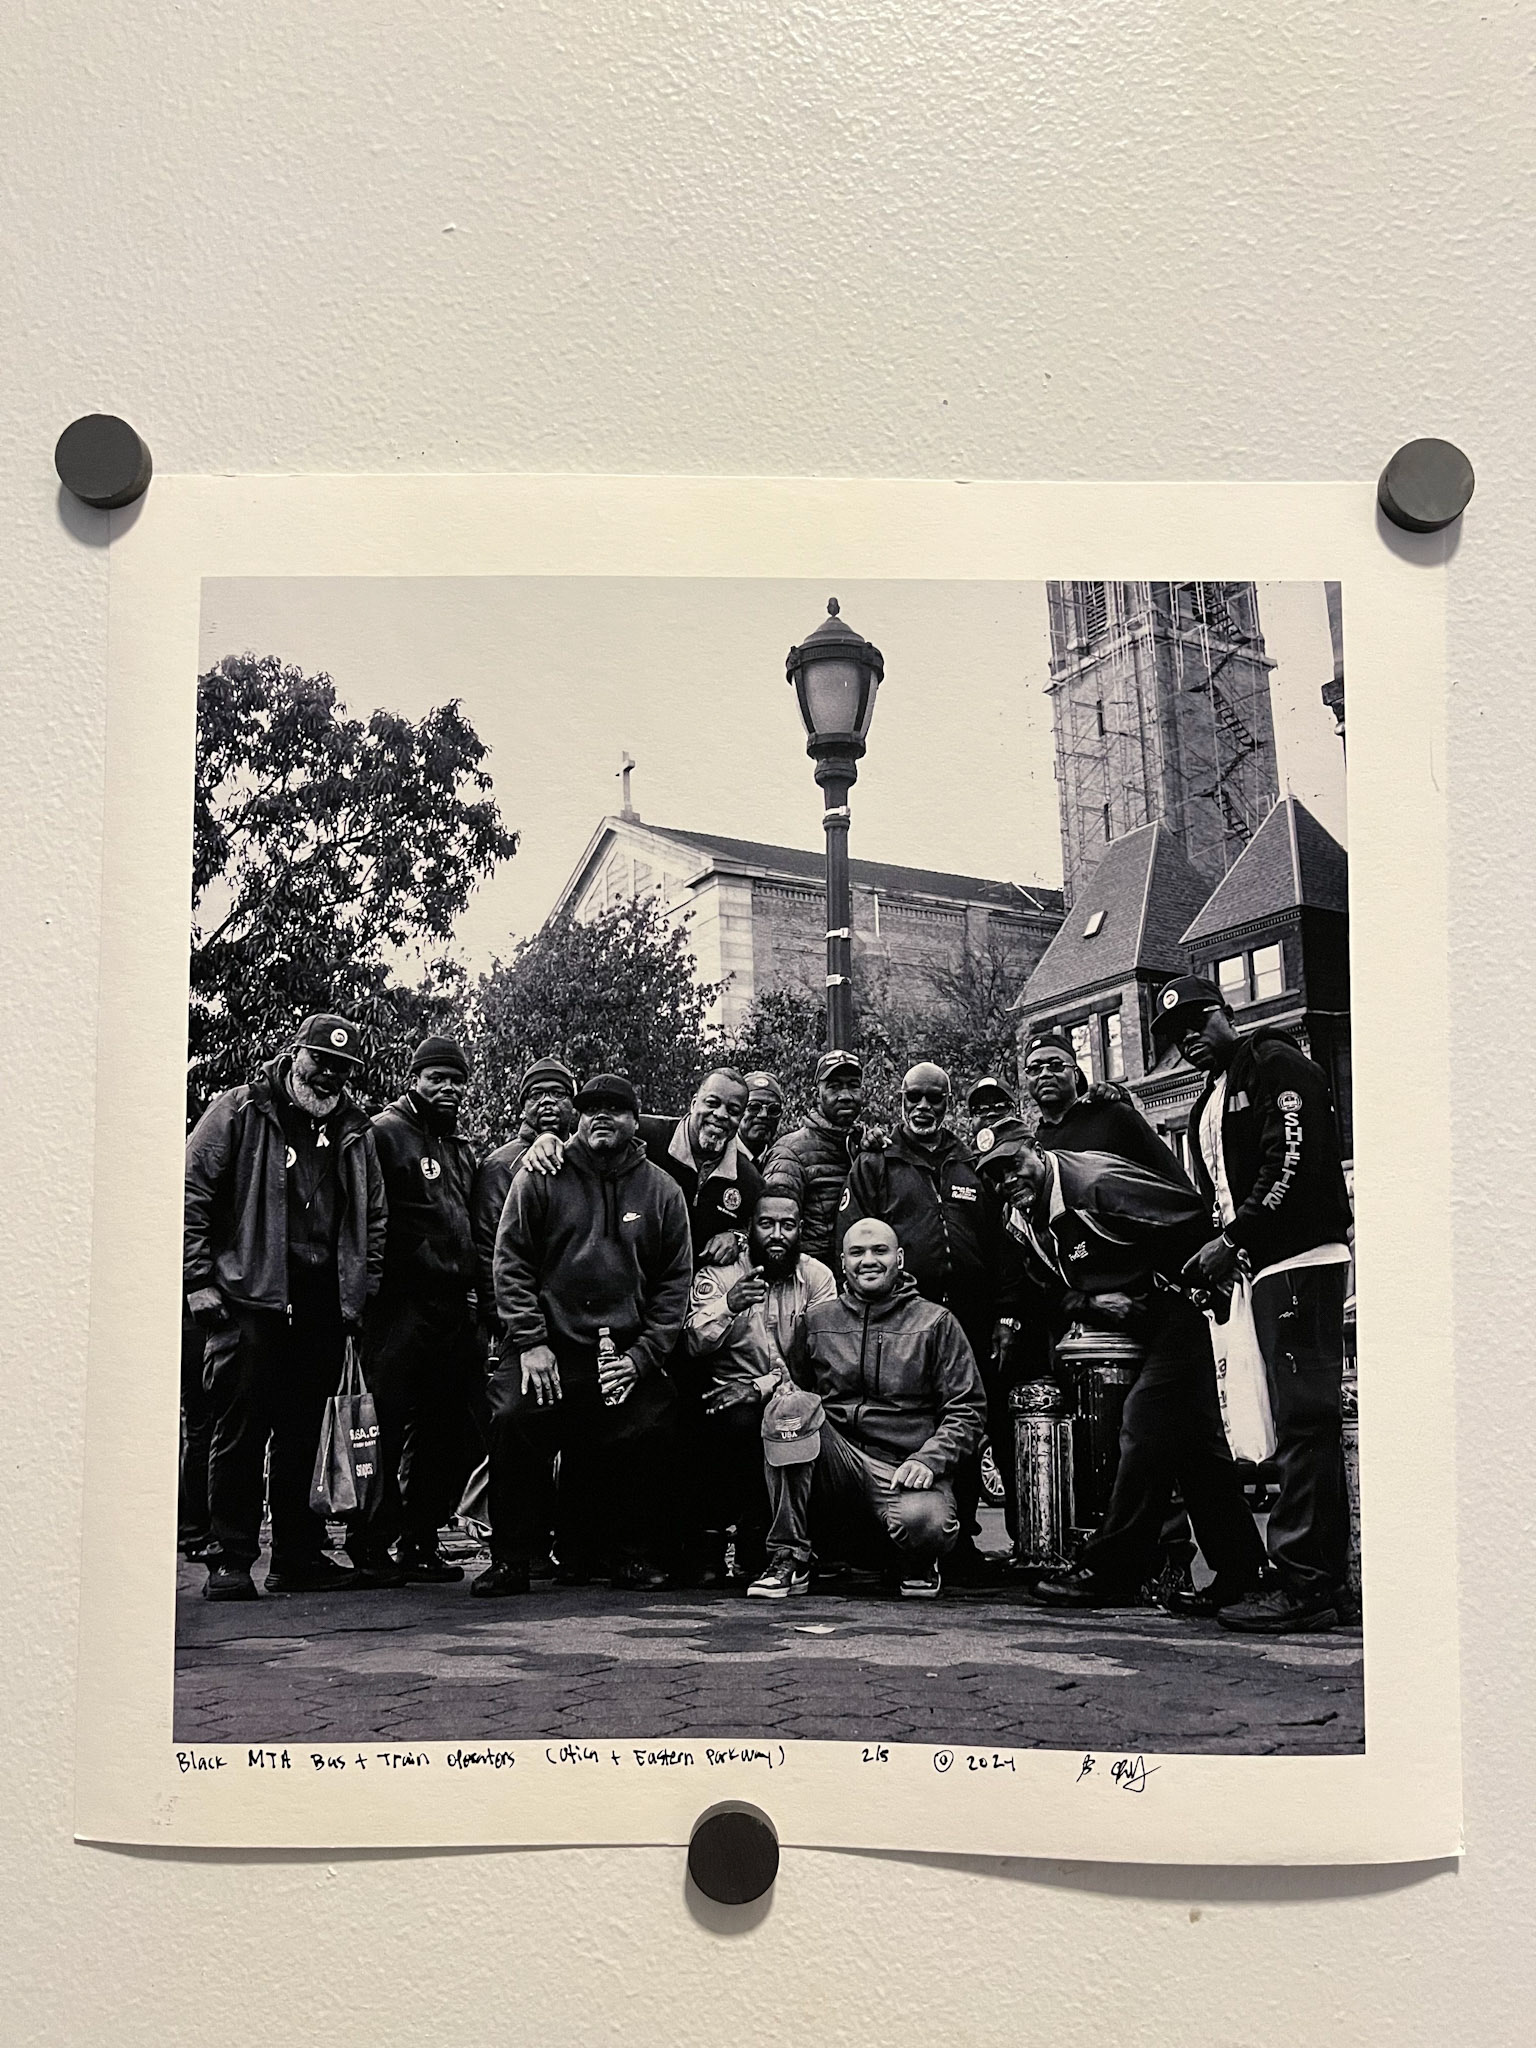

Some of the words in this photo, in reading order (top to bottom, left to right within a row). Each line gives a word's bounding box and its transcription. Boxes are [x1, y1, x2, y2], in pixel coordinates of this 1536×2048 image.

[1262, 1112, 1303, 1210] SHIFTER
[176, 1751, 228, 1773] Black
[248, 1750, 292, 1769] MTA
[311, 1753, 346, 1770] Bus
[355, 1753, 368, 1769] +
[377, 1752, 430, 1769] Train
[611, 1750, 621, 1766] +
[633, 1749, 694, 1766] Eastern
[862, 1745, 889, 1763] 2/5
[966, 1754, 1016, 1772] 2024
